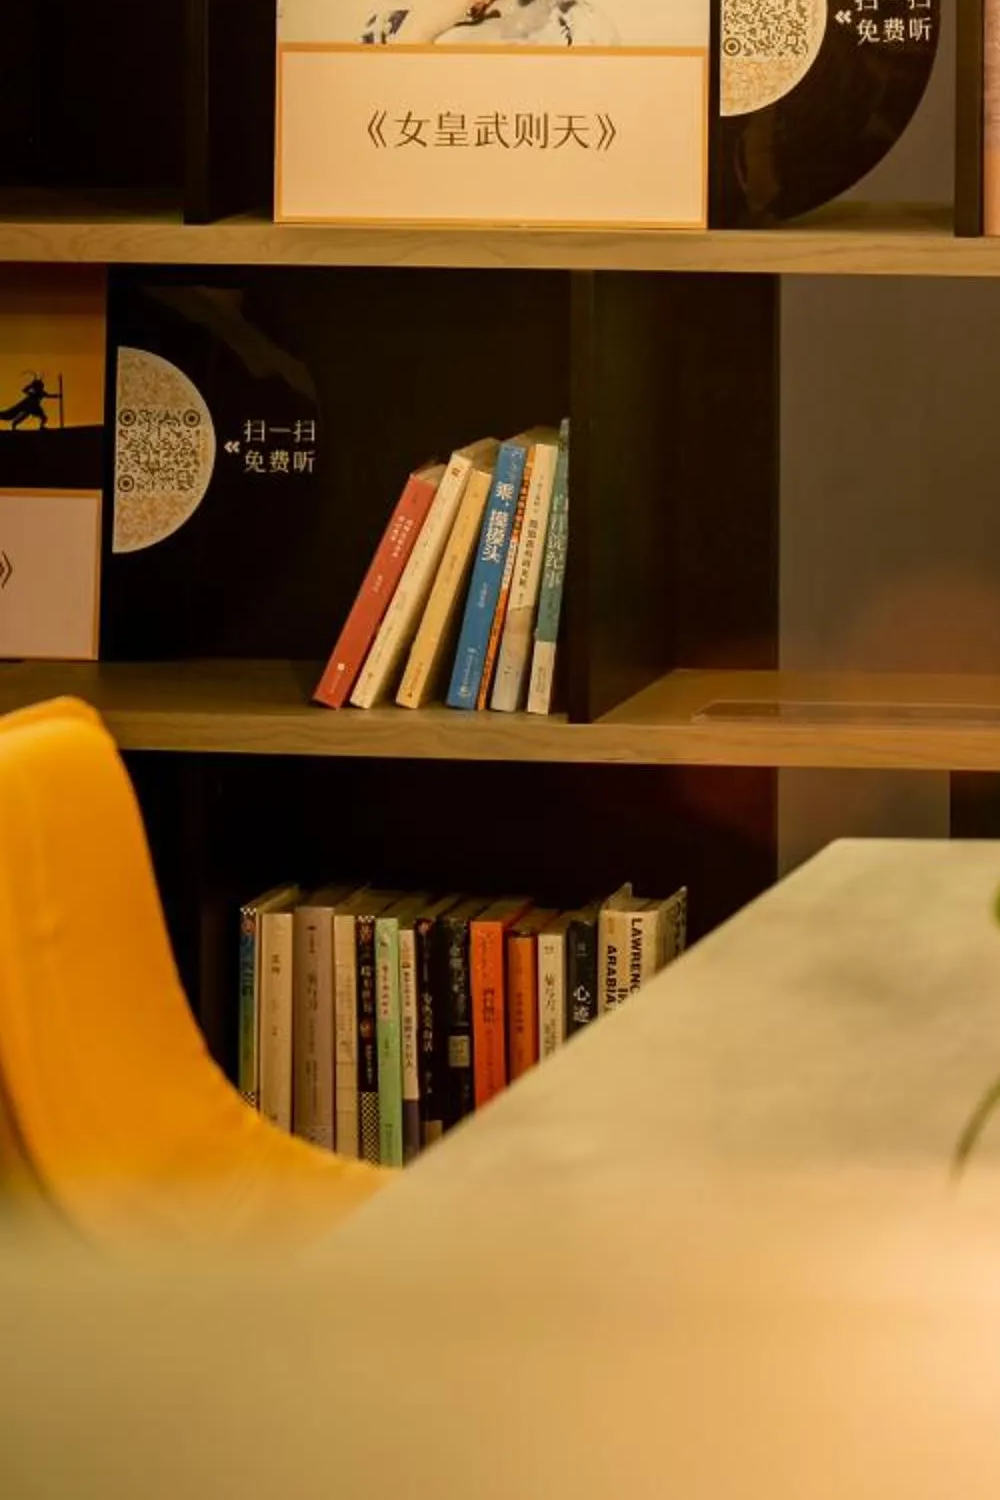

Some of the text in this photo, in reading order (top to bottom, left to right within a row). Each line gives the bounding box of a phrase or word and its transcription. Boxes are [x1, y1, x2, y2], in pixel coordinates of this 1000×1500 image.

[856, 17, 932, 46] 免费听
[367, 109, 617, 151] 《女皇武则天》
[243, 419, 316, 443] 扫一扫
[243, 448, 317, 474] 免费听
[629, 917, 643, 994] LAWRENC
